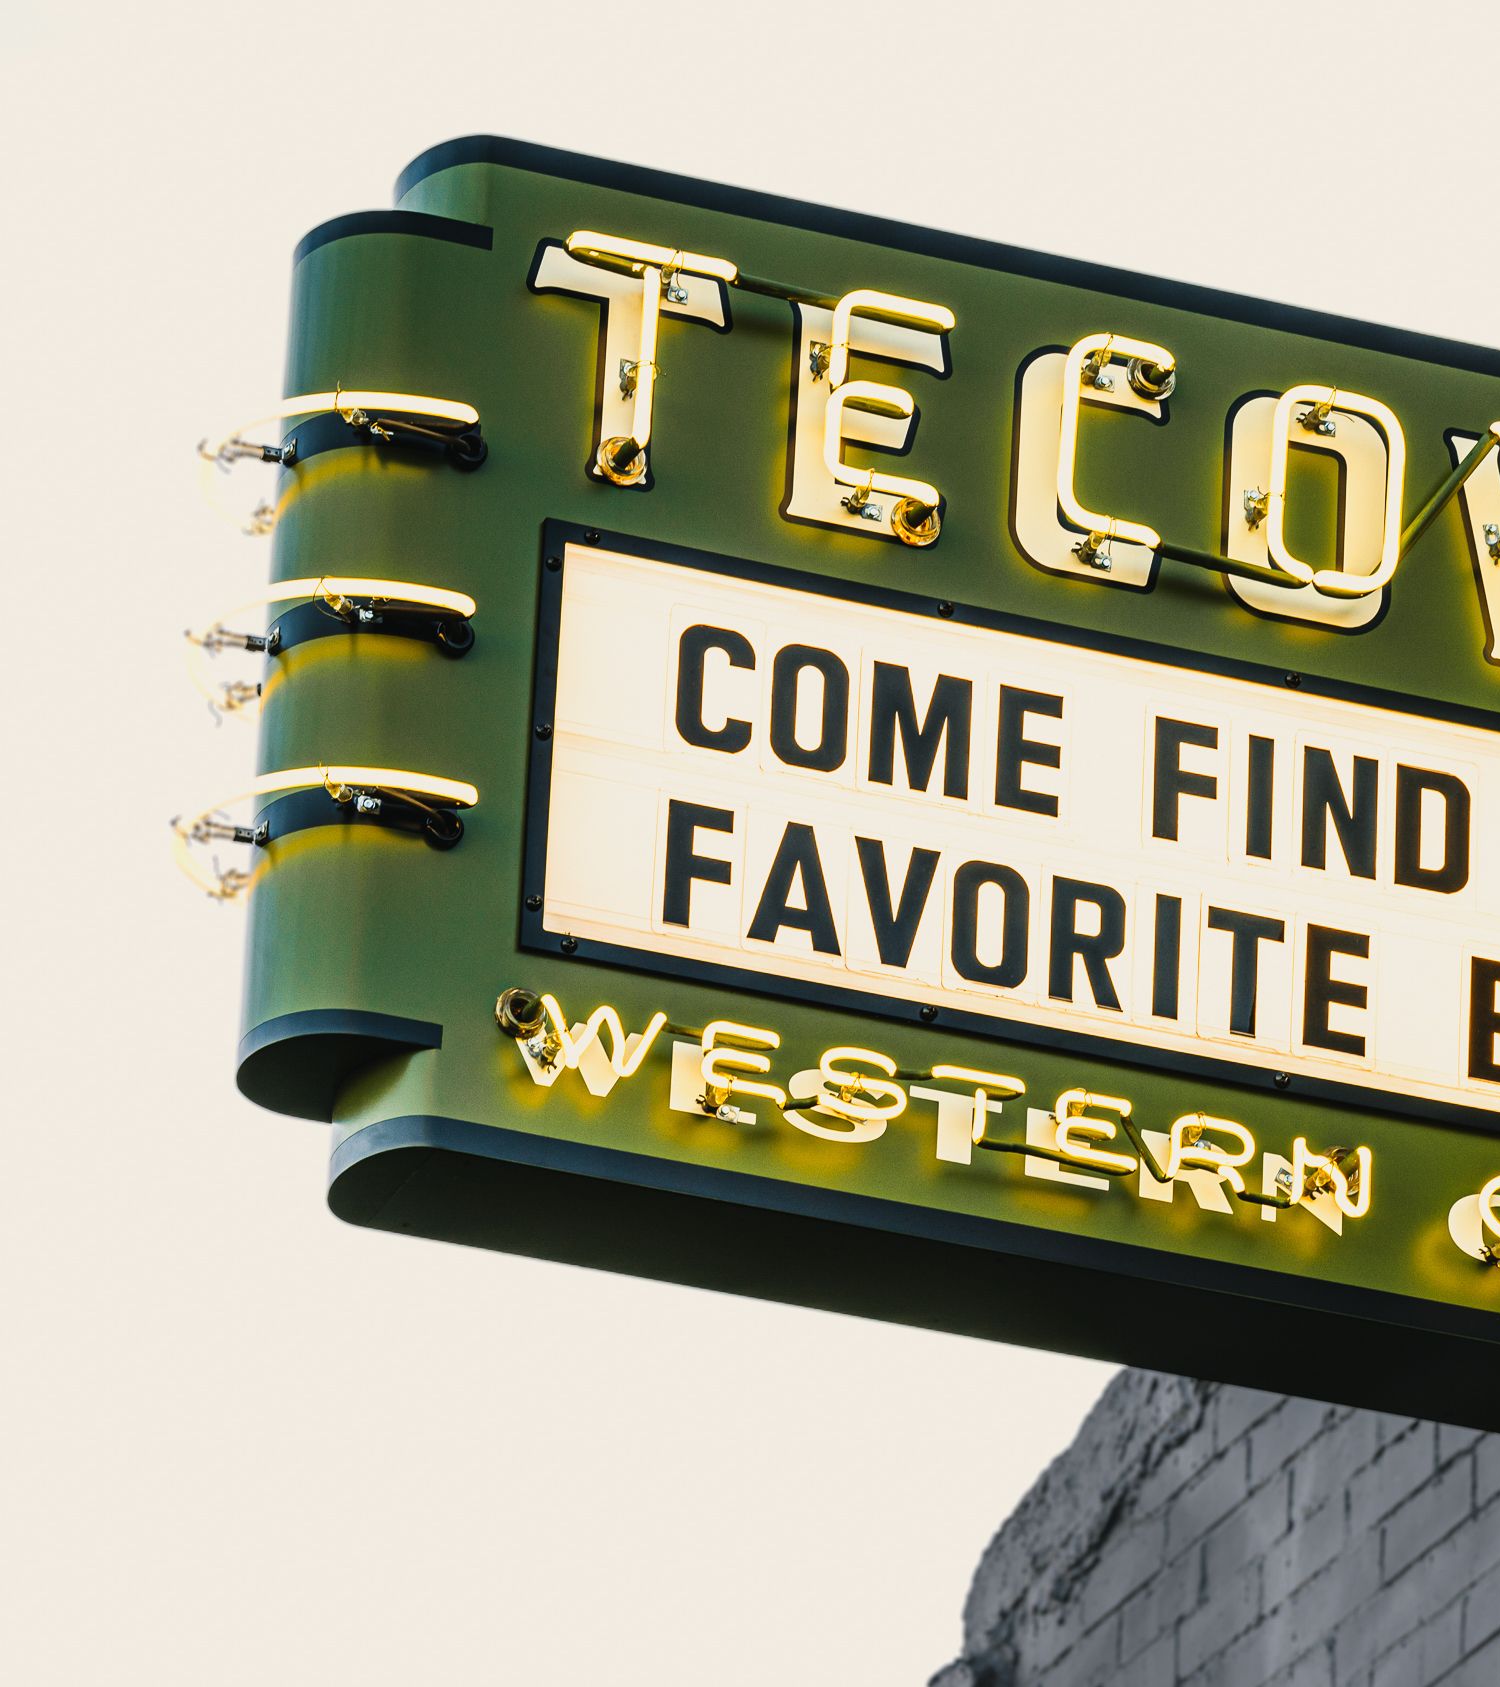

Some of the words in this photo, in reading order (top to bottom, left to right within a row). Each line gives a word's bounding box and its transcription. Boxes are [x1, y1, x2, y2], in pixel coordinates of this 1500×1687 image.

[675, 624, 1064, 817] COME
[1152, 716, 1471, 894] FIND
[662, 799, 1370, 1057] FAVORITE
[515, 994, 1372, 1236] WESTERN
